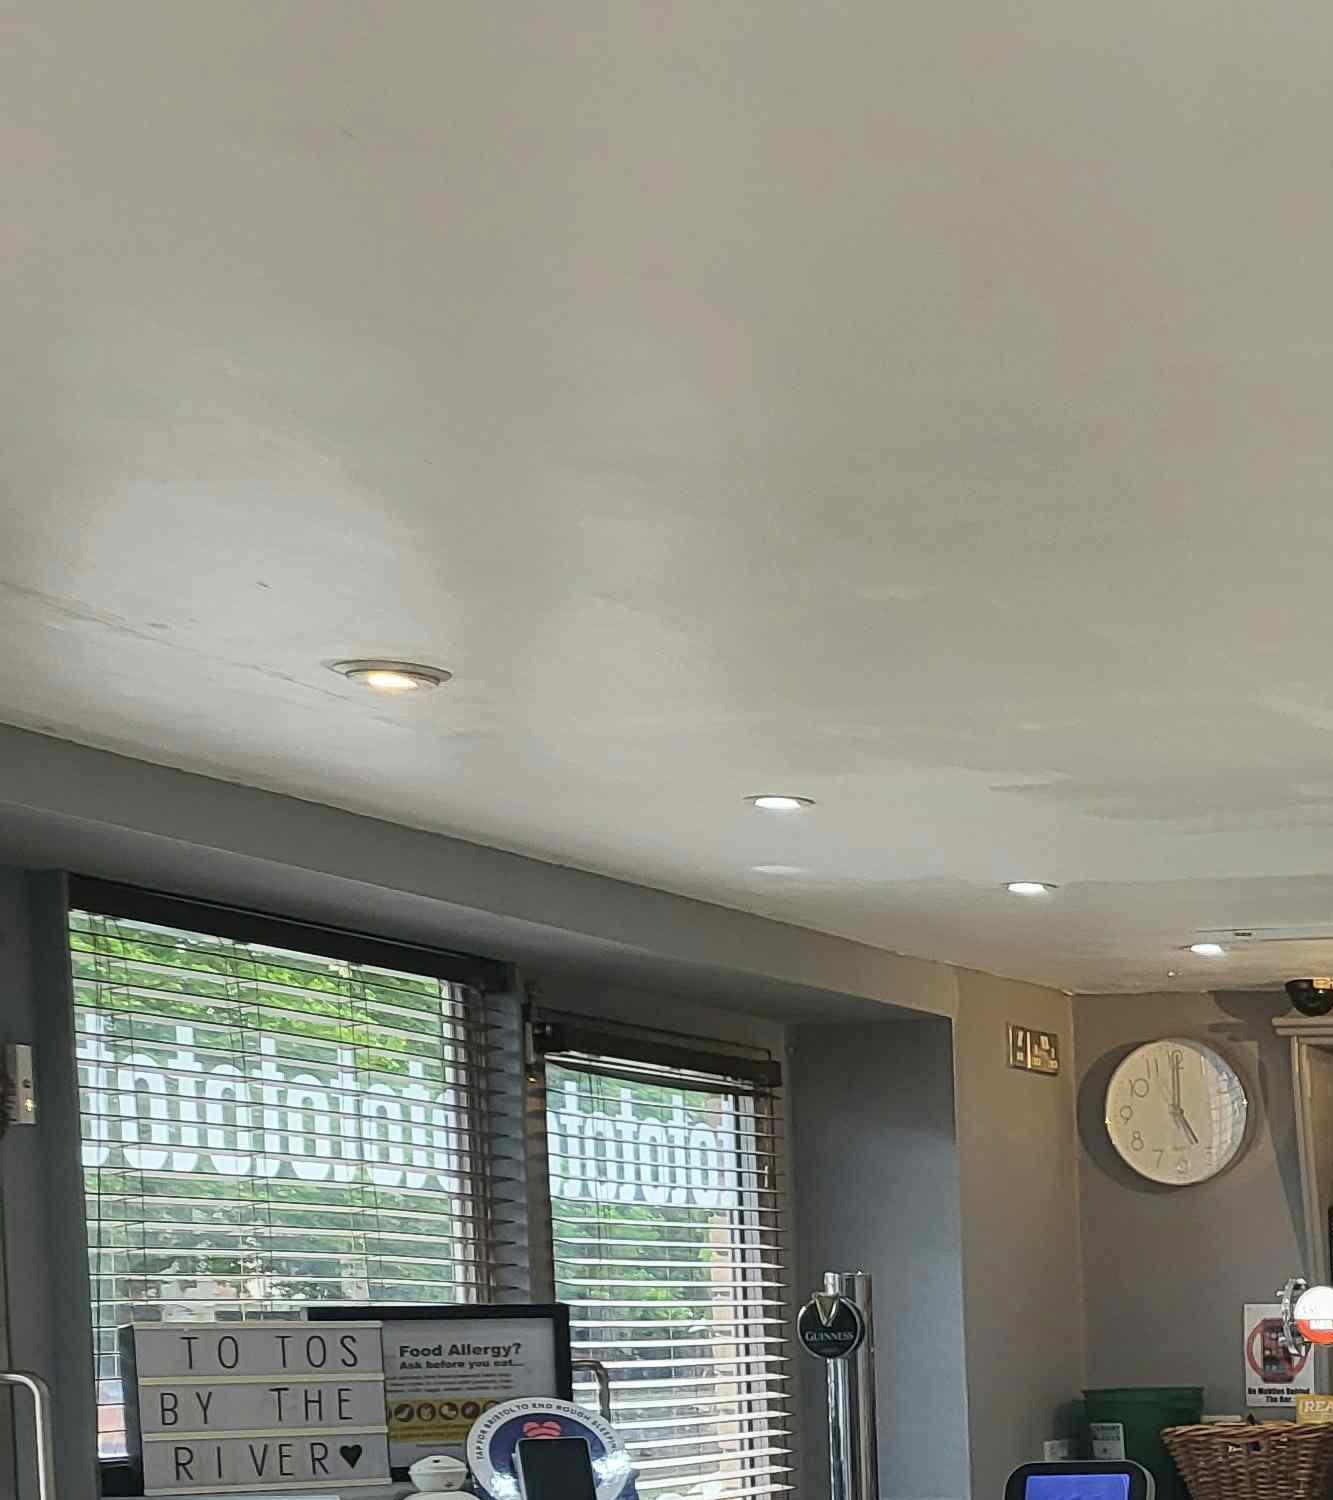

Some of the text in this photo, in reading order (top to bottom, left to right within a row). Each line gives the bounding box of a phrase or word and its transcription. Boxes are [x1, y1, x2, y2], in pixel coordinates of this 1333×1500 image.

[1130, 1131, 1145, 1152] 8
[805, 1331, 854, 1342] GUINNESS
[400, 1343, 522, 1358] Food Allergy?
[400, 1361, 422, 1370] Ask
[426, 1360, 466, 1369] before
[468, 1361, 490, 1370] you
[160, 1387, 353, 1426] BY THE
[174, 1442, 330, 1481] RIVER
